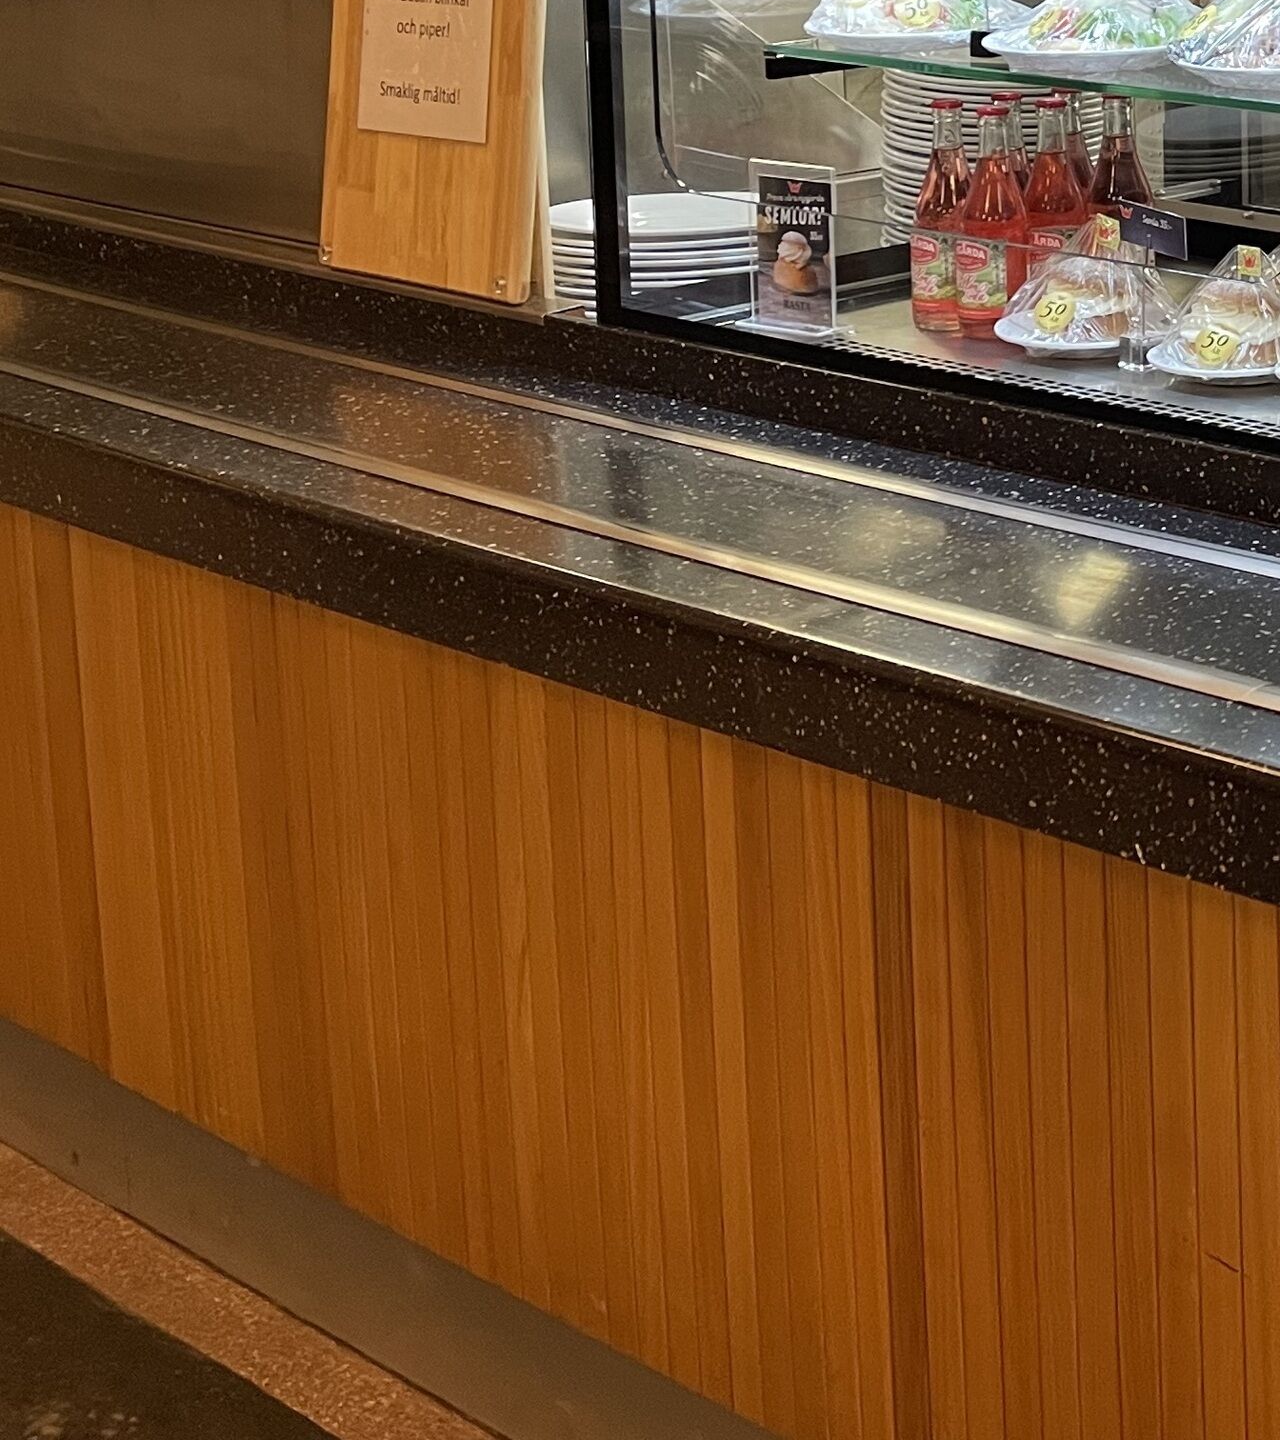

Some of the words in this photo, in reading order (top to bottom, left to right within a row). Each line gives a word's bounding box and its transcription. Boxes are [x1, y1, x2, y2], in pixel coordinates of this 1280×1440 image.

[397, 20, 416, 35] och
[419, 21, 450, 39] piper!
[380, 81, 420, 103] Smaklig
[422, 84, 460, 105] måltid!
[764, 206, 825, 226] SEMLOR!
[1039, 301, 1067, 318] 50
[1201, 331, 1229, 348] 50
